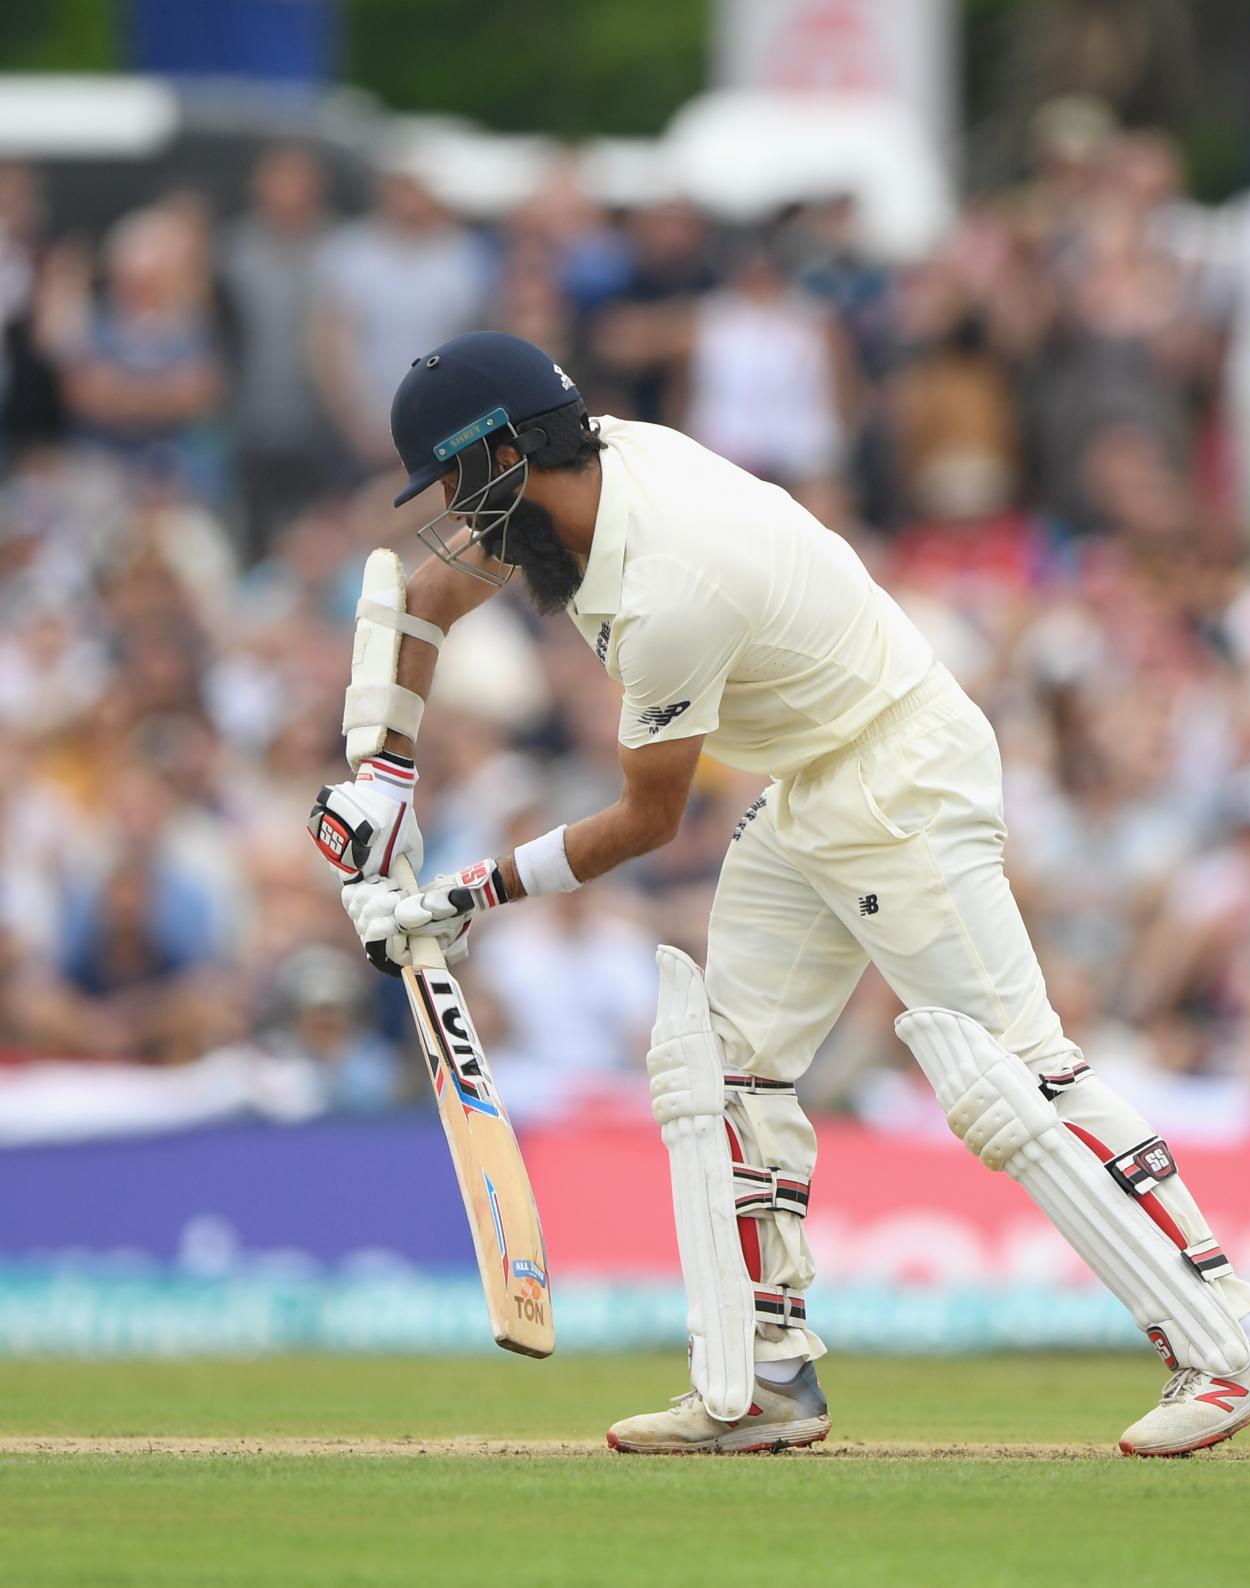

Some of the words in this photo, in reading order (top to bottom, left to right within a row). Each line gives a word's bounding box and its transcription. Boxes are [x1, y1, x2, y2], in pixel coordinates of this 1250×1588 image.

[319, 820, 345, 855] SS
[1144, 1147, 1170, 1173] SS
[515, 1261, 530, 1271] ALL
[513, 1295, 545, 1327] TON
